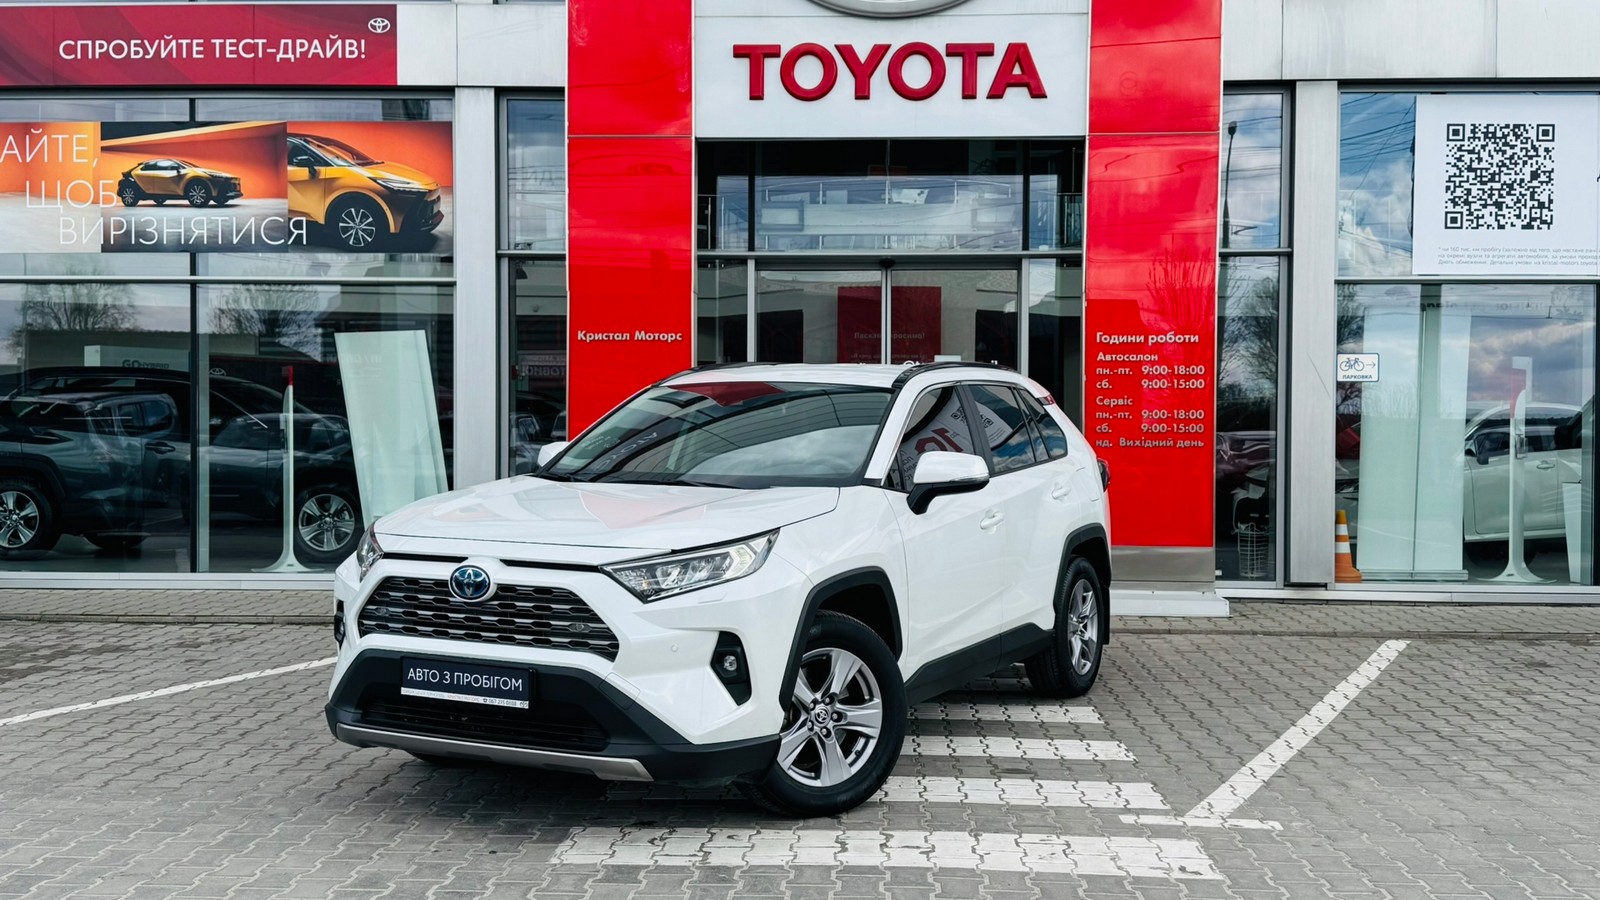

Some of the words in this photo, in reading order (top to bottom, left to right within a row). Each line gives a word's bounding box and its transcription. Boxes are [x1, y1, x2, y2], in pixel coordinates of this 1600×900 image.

[59, 35, 204, 60] СПРОБУЙТЕ
[212, 35, 366, 61] ТЕСТ-ДРАЙВ!
[733, 42, 1048, 101] TOYOTA
[0, 128, 98, 168] АЙТЕ,
[26, 179, 118, 214] ЩОБ
[59, 216, 308, 246] ВИРІЗНЯТИСЯ
[577, 330, 630, 343] Кристал
[634, 330, 682, 343] Моторс
[1096, 332, 1144, 344] Години
[1148, 331, 1199, 346] роботи
[1096, 352, 1158, 362] Автосалон
[1096, 366, 1134, 375] пн.-пт.
[1096, 379, 1112, 389] сб.
[1096, 395, 1133, 408] Сервіс
[1096, 411, 1134, 420] пн.-пт.
[1096, 424, 1112, 433] сб.
[1096, 439, 1113, 448] нд.
[1119, 437, 1174, 448] Вихідний
[1176, 439, 1204, 448] день
[407, 668, 440, 683] АВТО
[442, 671, 451, 684] З
[454, 672, 523, 692] ПРОБІГОМ
